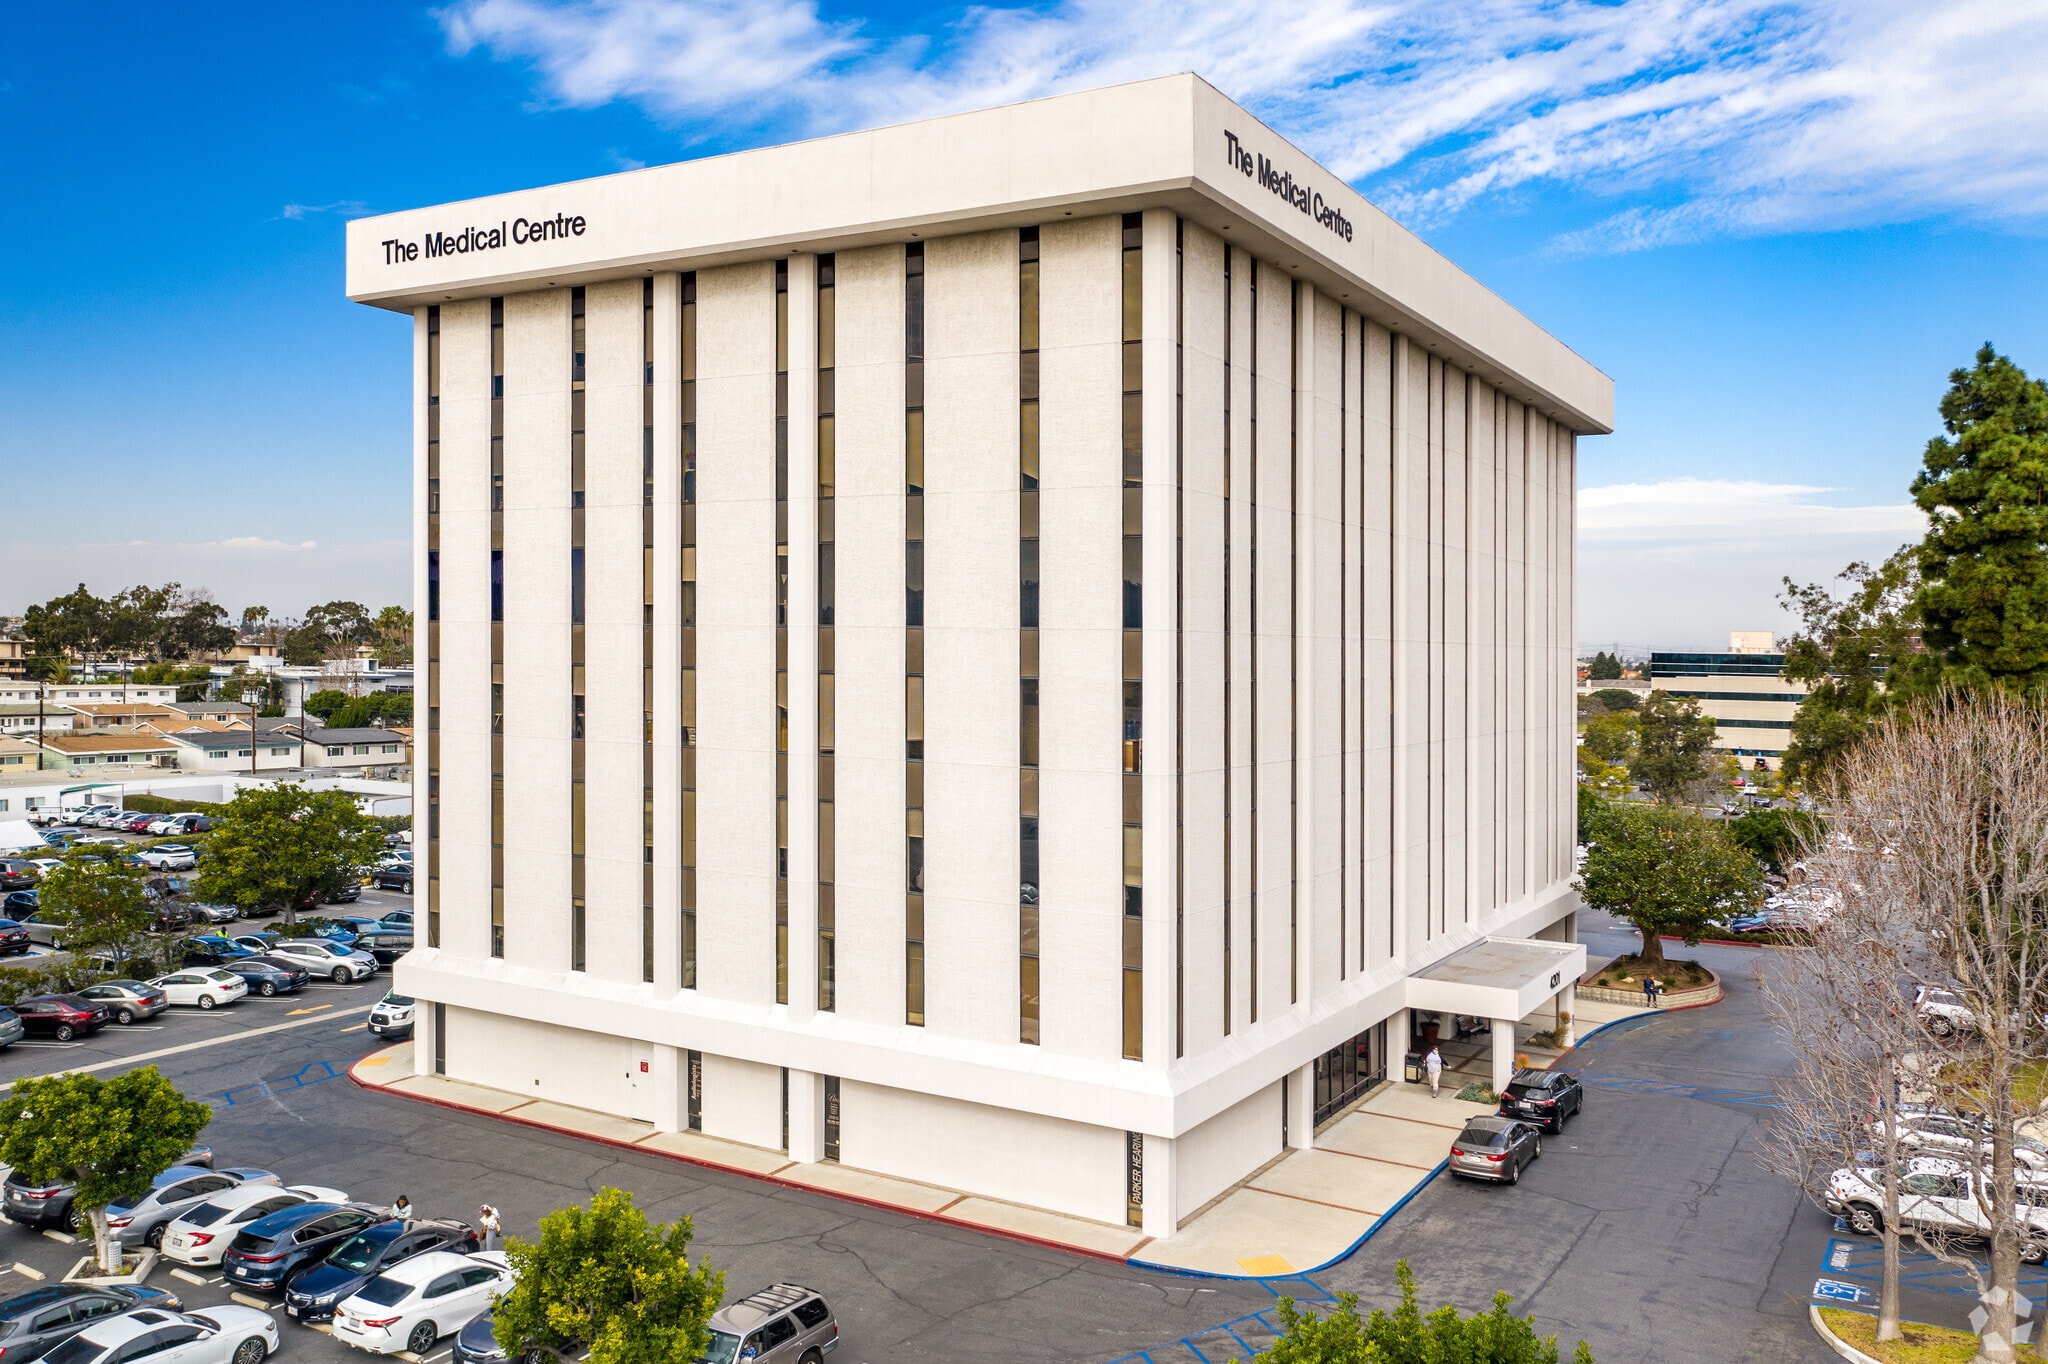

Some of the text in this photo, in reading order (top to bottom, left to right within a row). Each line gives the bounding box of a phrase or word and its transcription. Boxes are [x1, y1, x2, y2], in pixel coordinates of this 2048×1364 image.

[1224, 129, 1353, 243] The Medical Centre
[382, 212, 586, 265] The Medical Centre
[1132, 1132, 1142, 1203] PARKER HEARING
